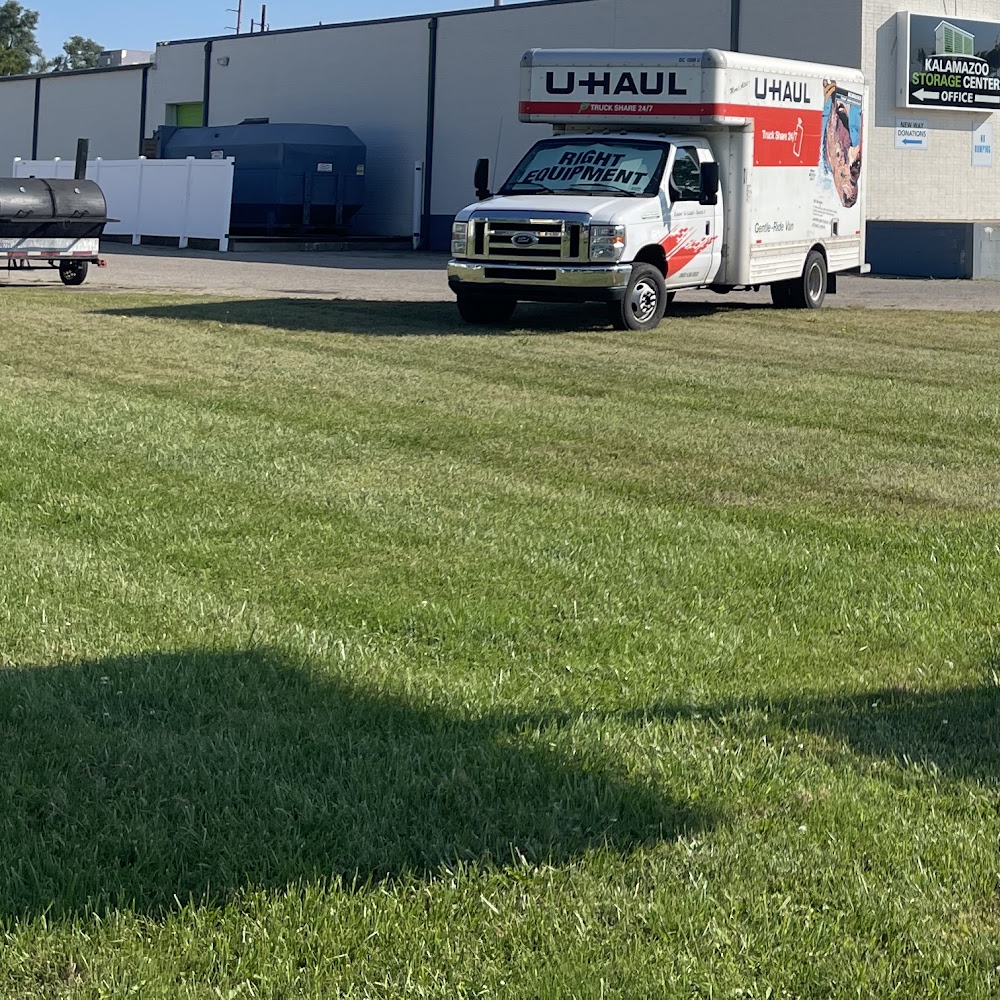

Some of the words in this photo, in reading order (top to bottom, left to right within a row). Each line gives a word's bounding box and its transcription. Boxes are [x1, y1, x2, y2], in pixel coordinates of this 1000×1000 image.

[924, 58, 990, 76] KALAMAZOO
[546, 71, 688, 95] U-HAUL
[754, 77, 811, 104] U-HAUL
[912, 72, 962, 88] STORAGE
[962, 75, 1000, 91] CENTER
[940, 90, 974, 103] OFFICE
[590, 103, 613, 112] TRUCK
[614, 104, 637, 112] SHARE
[637, 104, 653, 112] 24/7
[897, 129, 927, 137] DONATIONS
[558, 149, 627, 167] RIGHT
[522, 165, 649, 185] EQUIPMENT
[785, 220, 794, 232] Van
